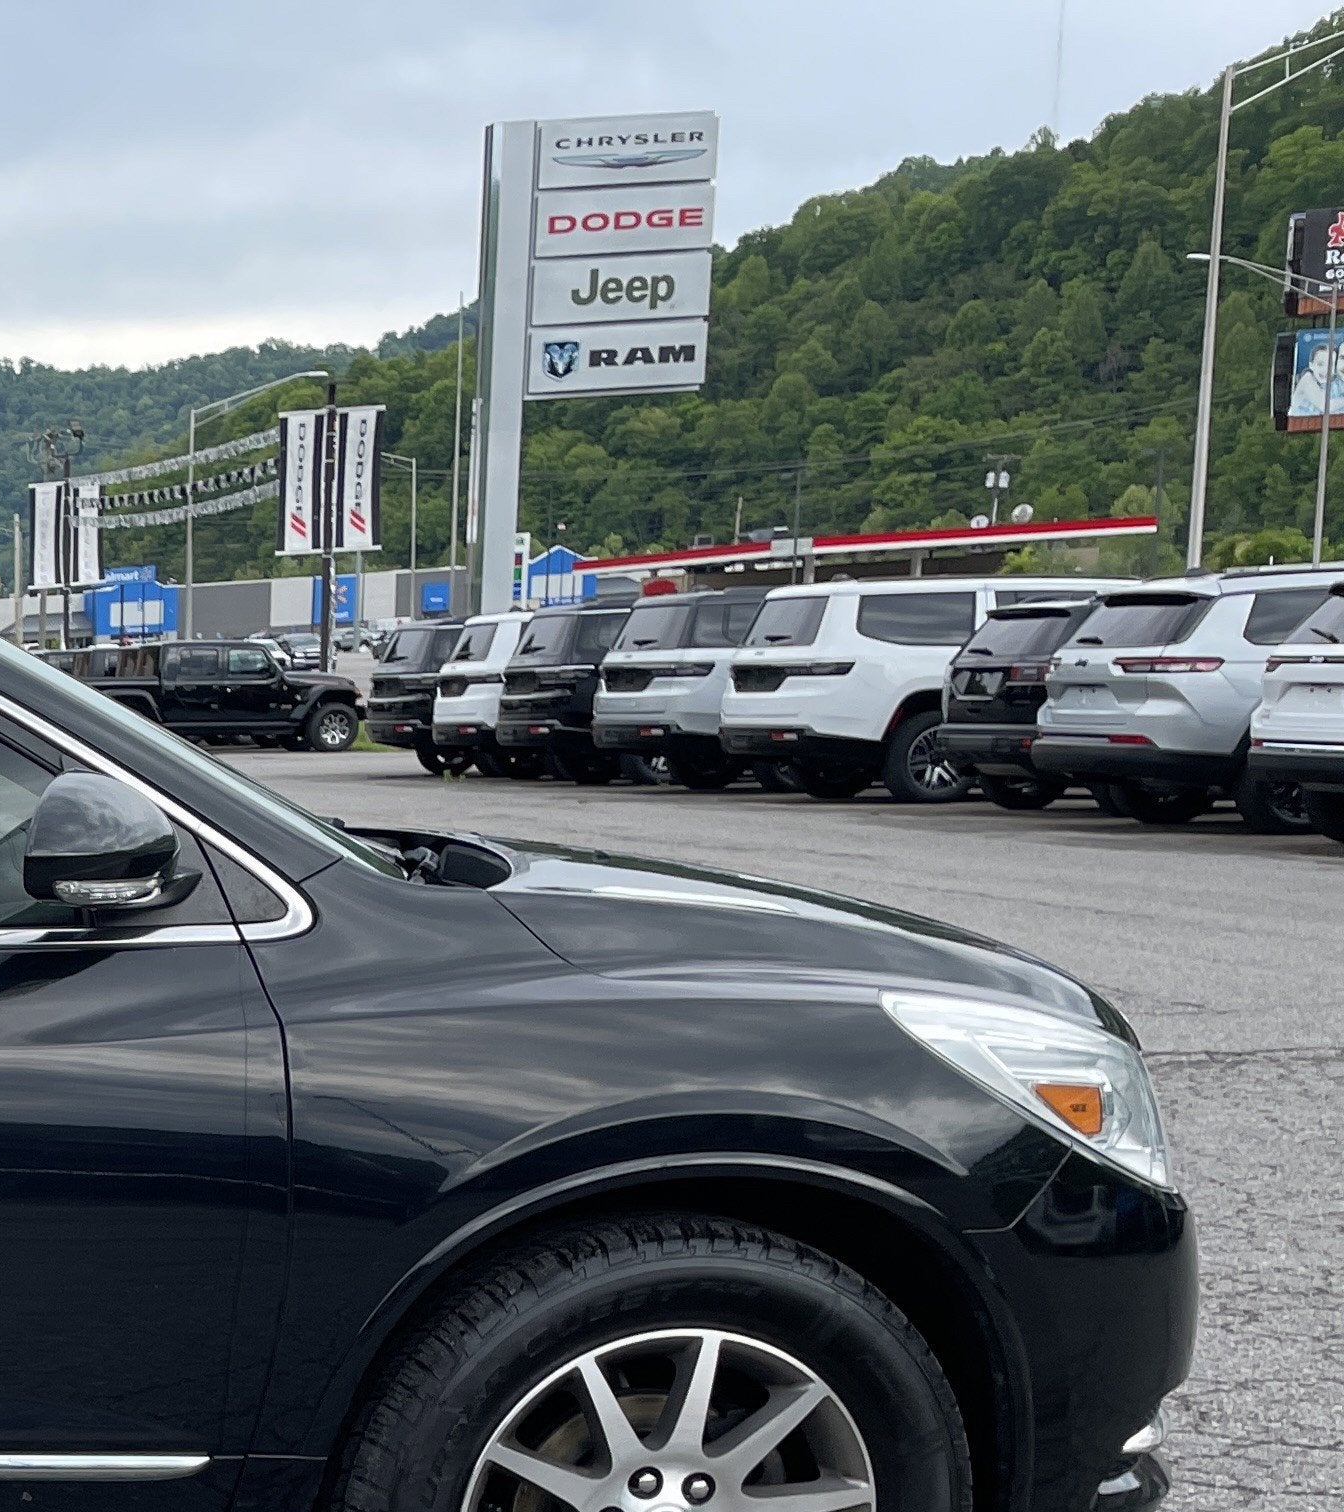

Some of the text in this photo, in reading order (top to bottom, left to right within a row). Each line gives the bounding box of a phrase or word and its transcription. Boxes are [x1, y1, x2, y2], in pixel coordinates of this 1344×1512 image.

[554, 130, 705, 150] CHRYSLER
[547, 207, 704, 235] DODGE
[570, 268, 675, 310] Jeep
[588, 343, 696, 368] RAM
[294, 423, 306, 520] DODGE
[354, 419, 368, 513] DODGE
